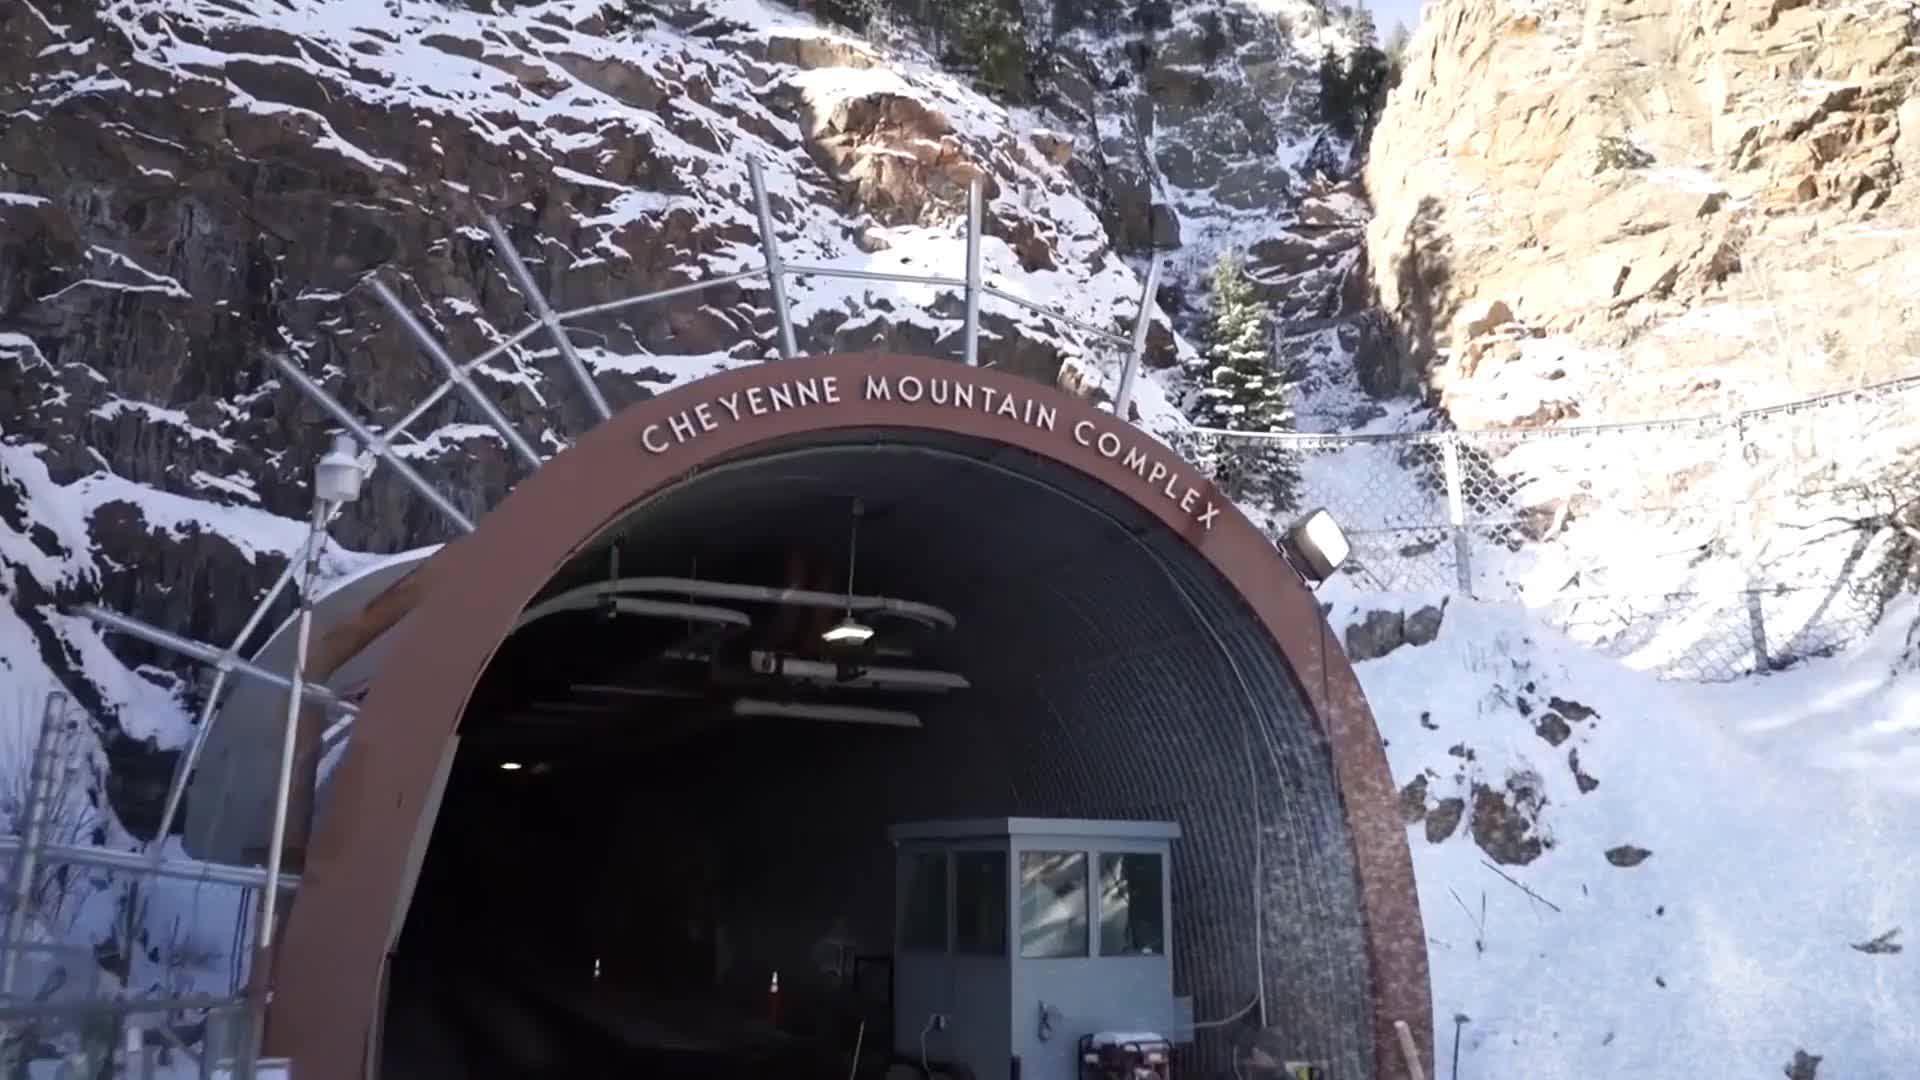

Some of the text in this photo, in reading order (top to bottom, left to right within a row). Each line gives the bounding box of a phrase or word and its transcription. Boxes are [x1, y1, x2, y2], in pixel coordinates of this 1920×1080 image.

[641, 375, 1221, 530] CHEYENNE MOUNTAIN COMPLEX
